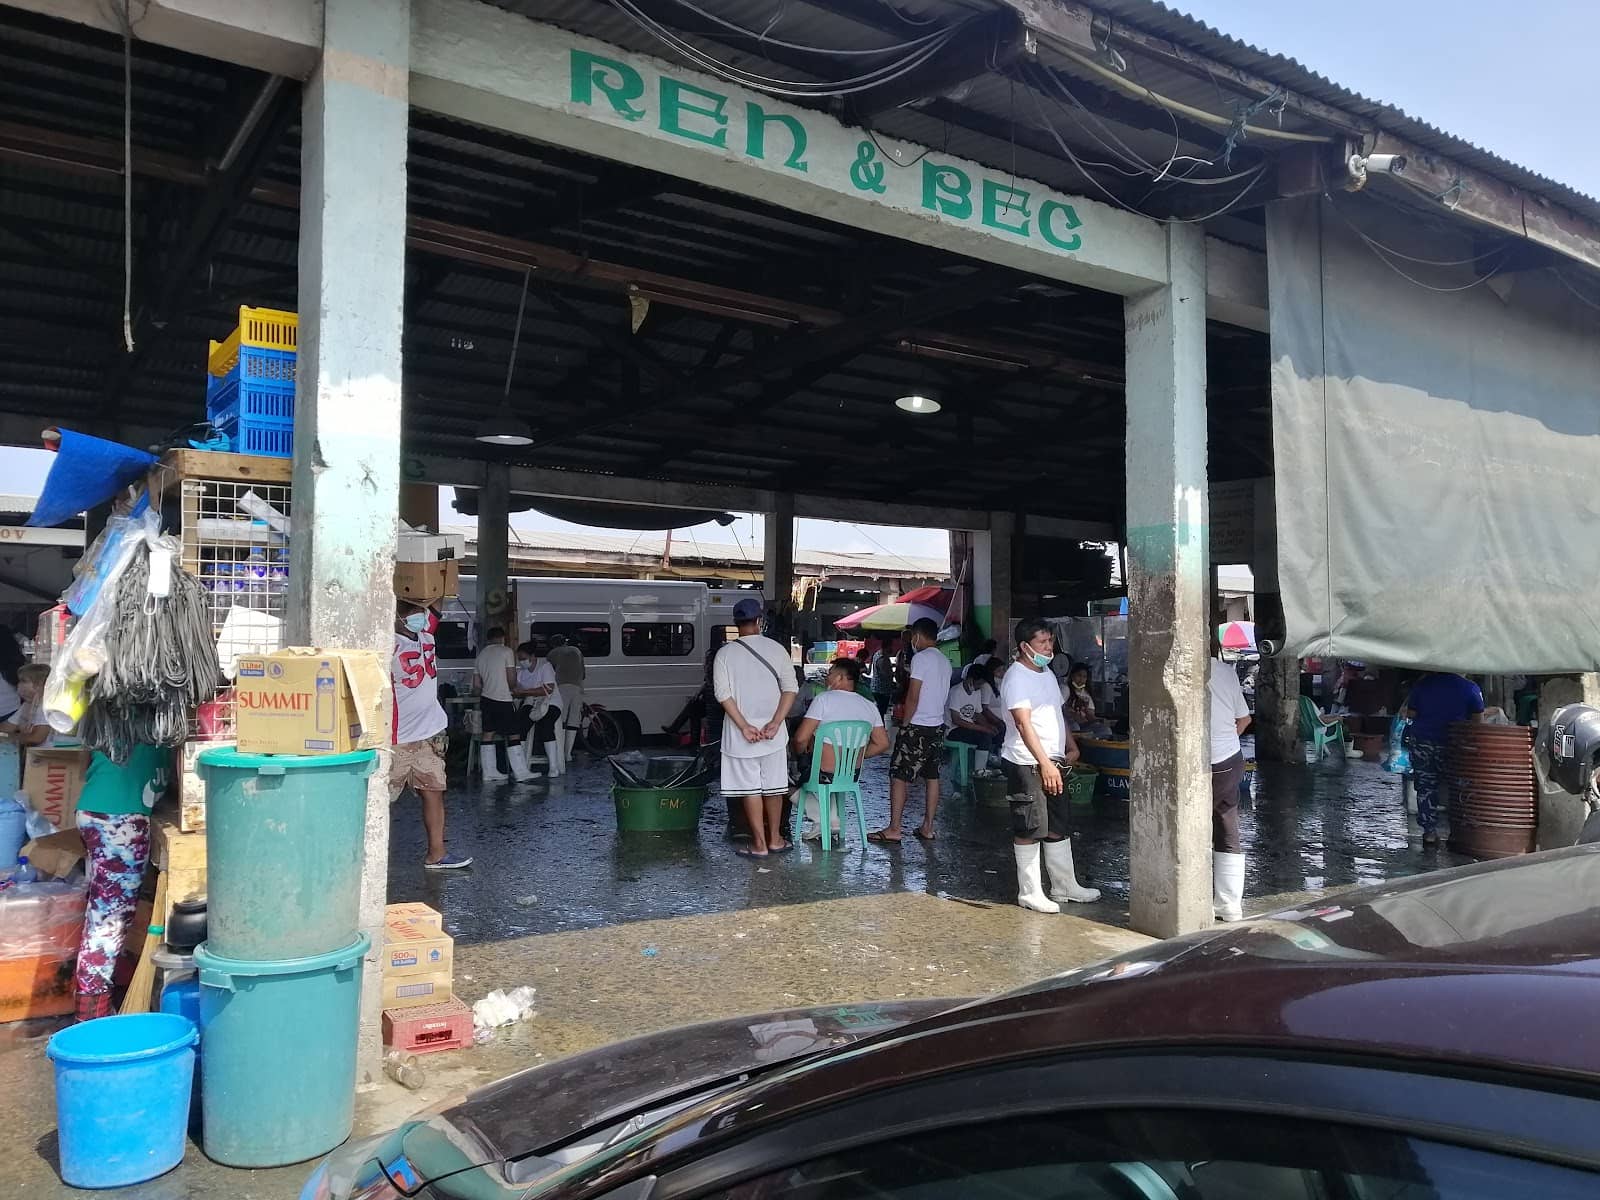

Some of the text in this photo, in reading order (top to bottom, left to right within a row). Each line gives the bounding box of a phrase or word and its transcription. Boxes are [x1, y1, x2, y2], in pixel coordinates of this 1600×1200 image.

[850, 140, 886, 194] &
[921, 159, 1083, 251] BEC
[239, 691, 313, 711] SUMMIT
